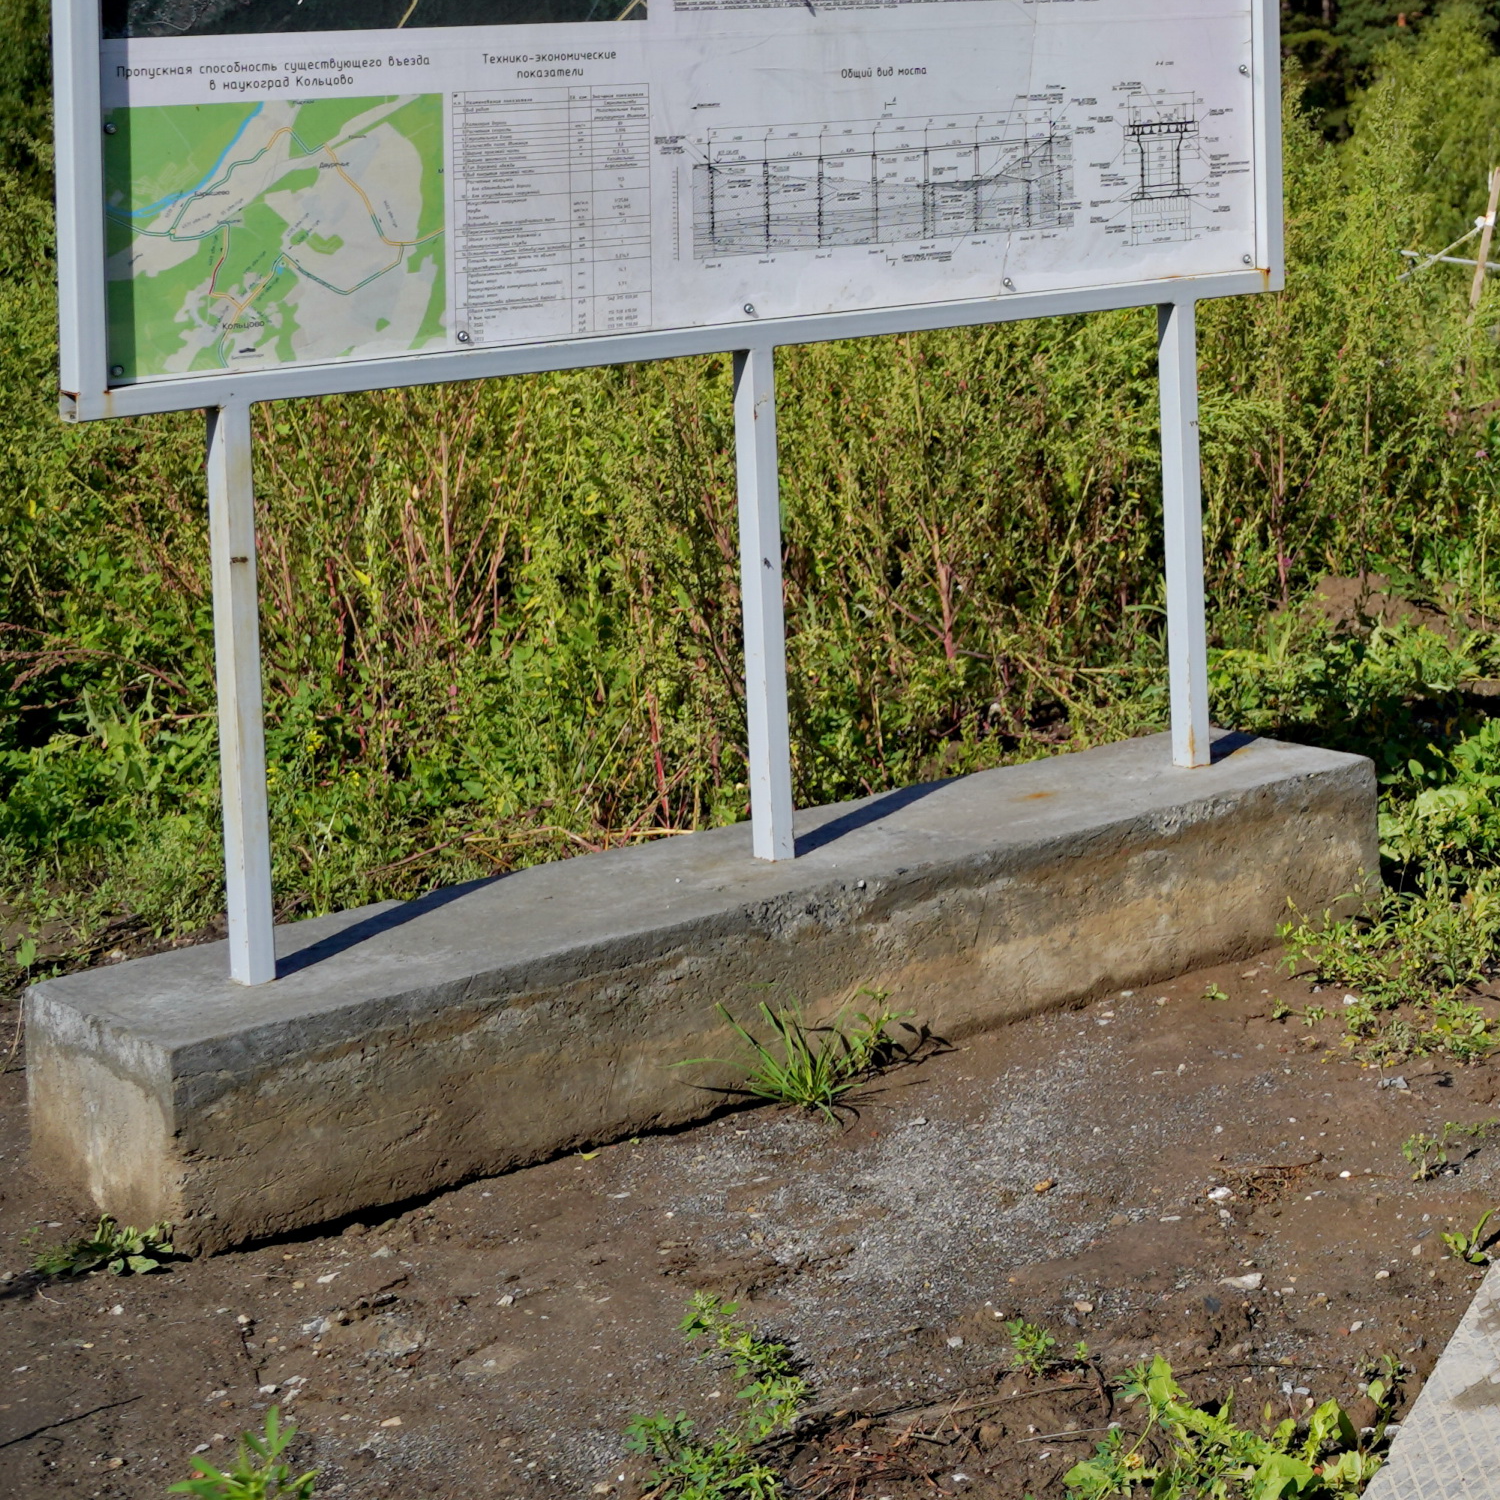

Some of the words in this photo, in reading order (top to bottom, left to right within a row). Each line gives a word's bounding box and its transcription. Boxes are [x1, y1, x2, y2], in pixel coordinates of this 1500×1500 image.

[482, 50, 617, 64] Технико-экономические
[117, 66, 192, 82] Пропускная
[199, 60, 277, 76] способность
[284, 57, 382, 73] существующего
[388, 53, 430, 68] въезда
[516, 66, 584, 81] показатели
[841, 68, 872, 80] Общий
[878, 68, 894, 78] вид
[898, 66, 927, 77] моста
[209, 82, 216, 91] в
[223, 78, 289, 94] наукоград
[296, 76, 354, 90] Кольцово
[223, 320, 265, 329] Кольцово
